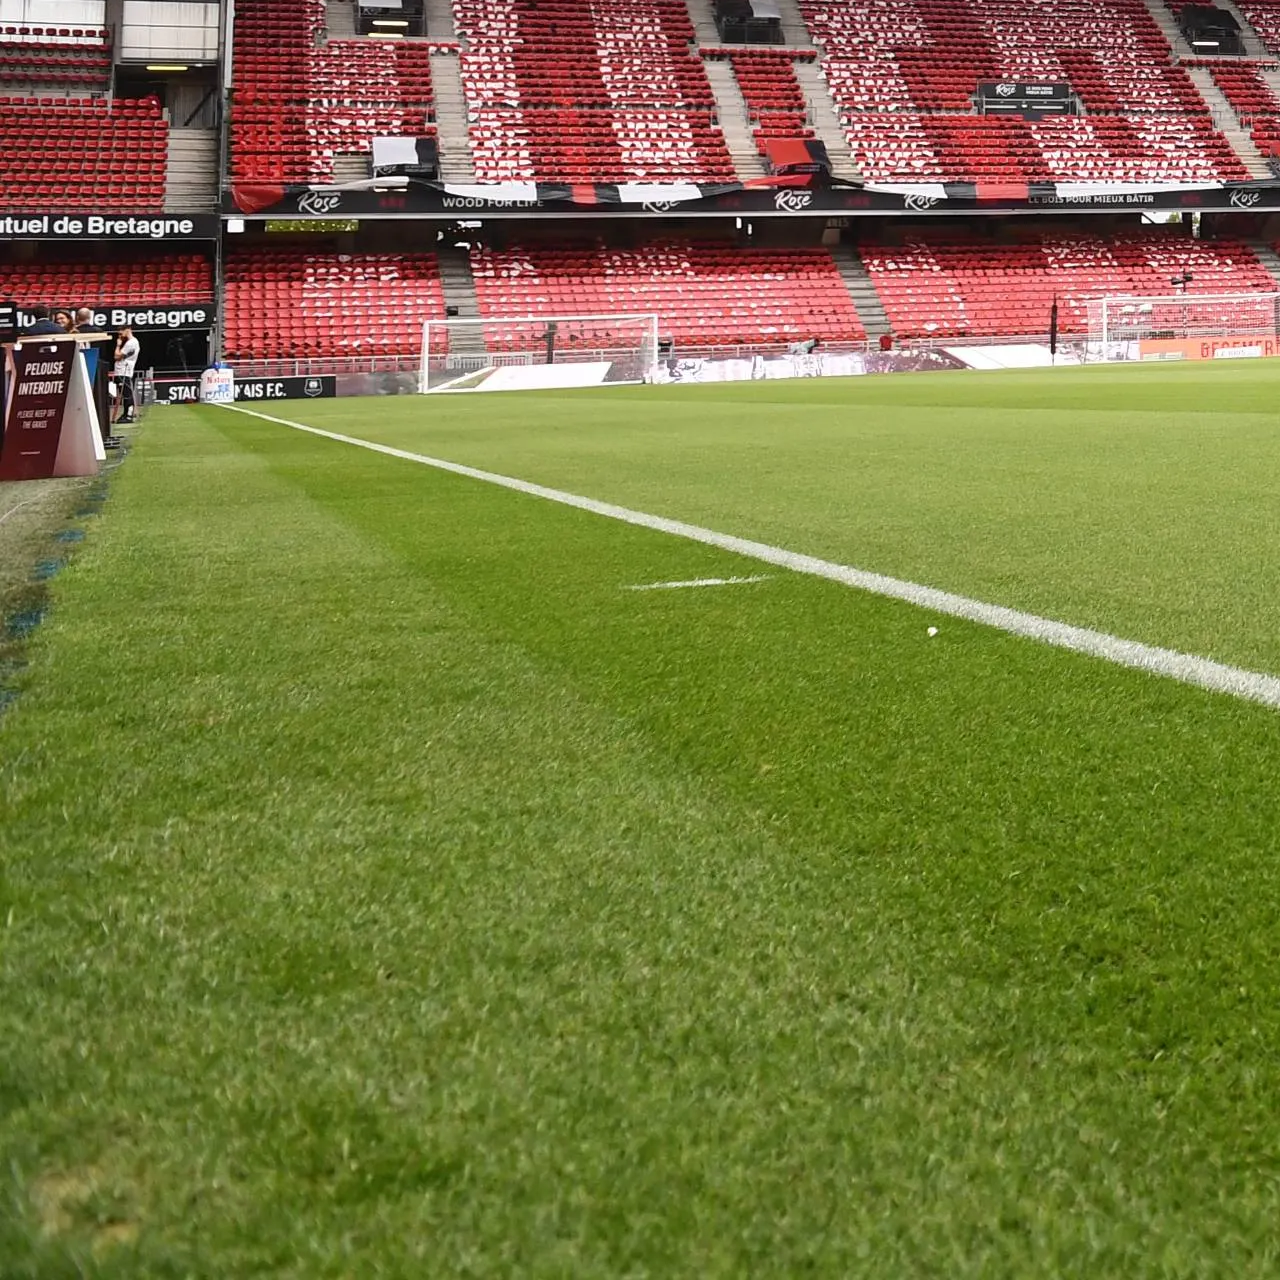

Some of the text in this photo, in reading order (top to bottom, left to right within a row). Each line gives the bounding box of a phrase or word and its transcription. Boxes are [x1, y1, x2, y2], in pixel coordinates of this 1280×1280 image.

[442, 197, 544, 208] WOOD FOR LIFE
[1066, 195, 1091, 204] POUR
[1094, 194, 1124, 203] MIEUX
[0, 216, 193, 237] tuel de Bretagne
[112, 309, 206, 327] Bretagne
[25, 361, 64, 376] PELOUSE
[18, 380, 64, 396] INTERDITE
[267, 383, 286, 397] F.C.
